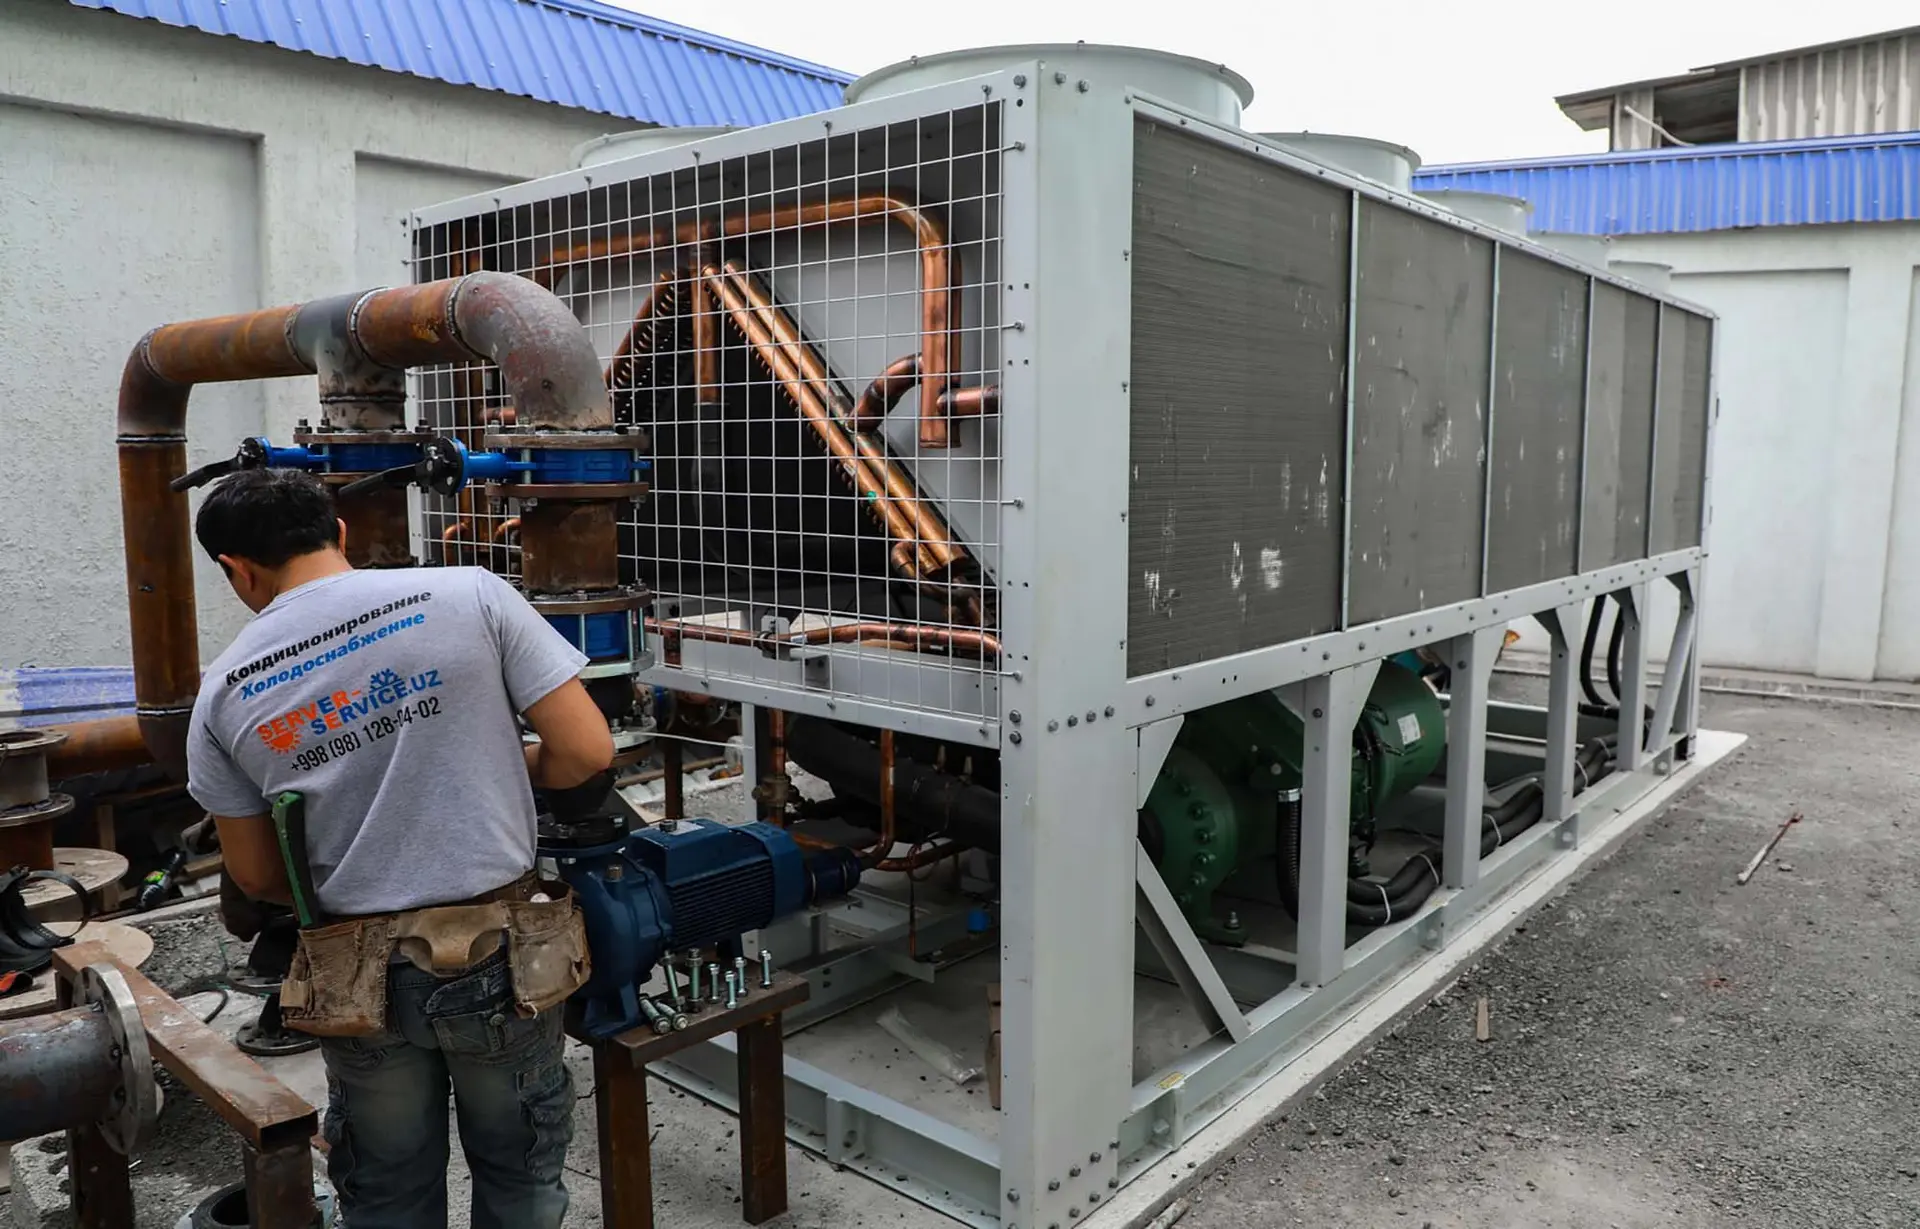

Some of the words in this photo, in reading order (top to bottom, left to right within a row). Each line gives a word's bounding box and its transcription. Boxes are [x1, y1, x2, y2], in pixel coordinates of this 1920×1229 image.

[225, 591, 432, 686] Кондиционирование
[241, 612, 425, 700] Холодоснабжение
[311, 669, 443, 735] SERVICE.UZ
[291, 745, 329, 771] +998
[328, 731, 361, 758] (98)
